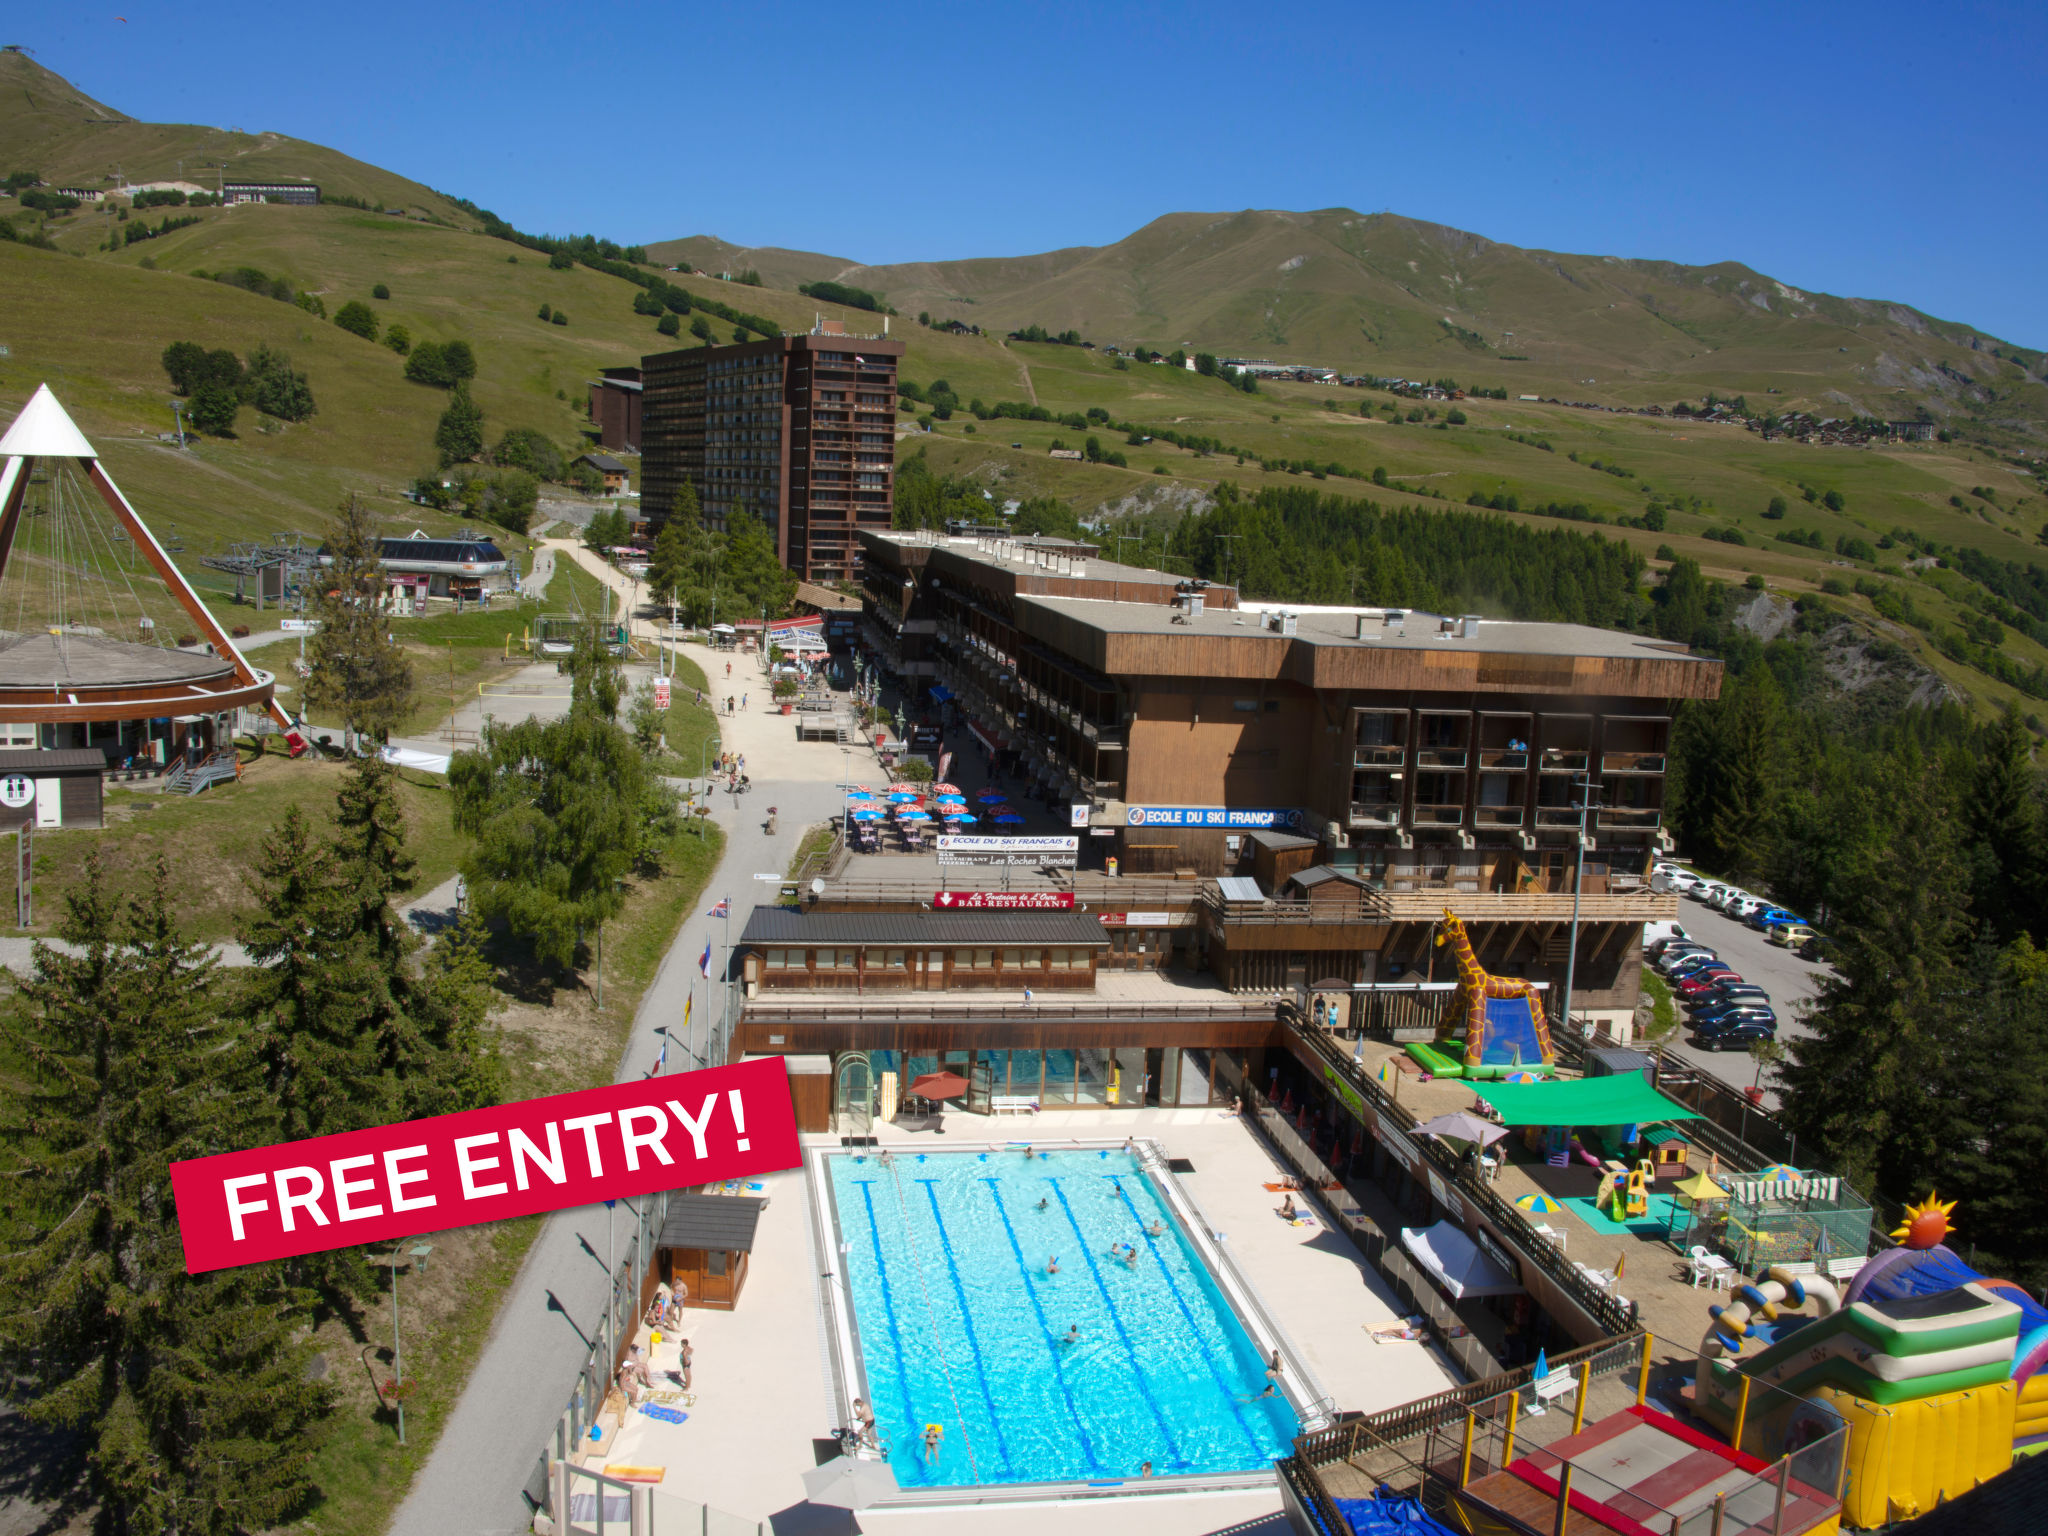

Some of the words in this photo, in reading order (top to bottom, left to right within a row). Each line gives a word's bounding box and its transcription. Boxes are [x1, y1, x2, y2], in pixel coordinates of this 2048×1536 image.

[1146, 811, 1182, 823] ECOLE
[1187, 811, 1202, 823] DU
[1207, 811, 1225, 823] SKI
[1229, 812, 1285, 825] FRANÇAIS
[989, 855, 1005, 865] Les
[1007, 855, 1037, 865] Roches
[1039, 855, 1076, 865] Blanches
[969, 892, 982, 901] La
[984, 892, 1016, 901] Fontaine
[1018, 893, 1029, 901] de
